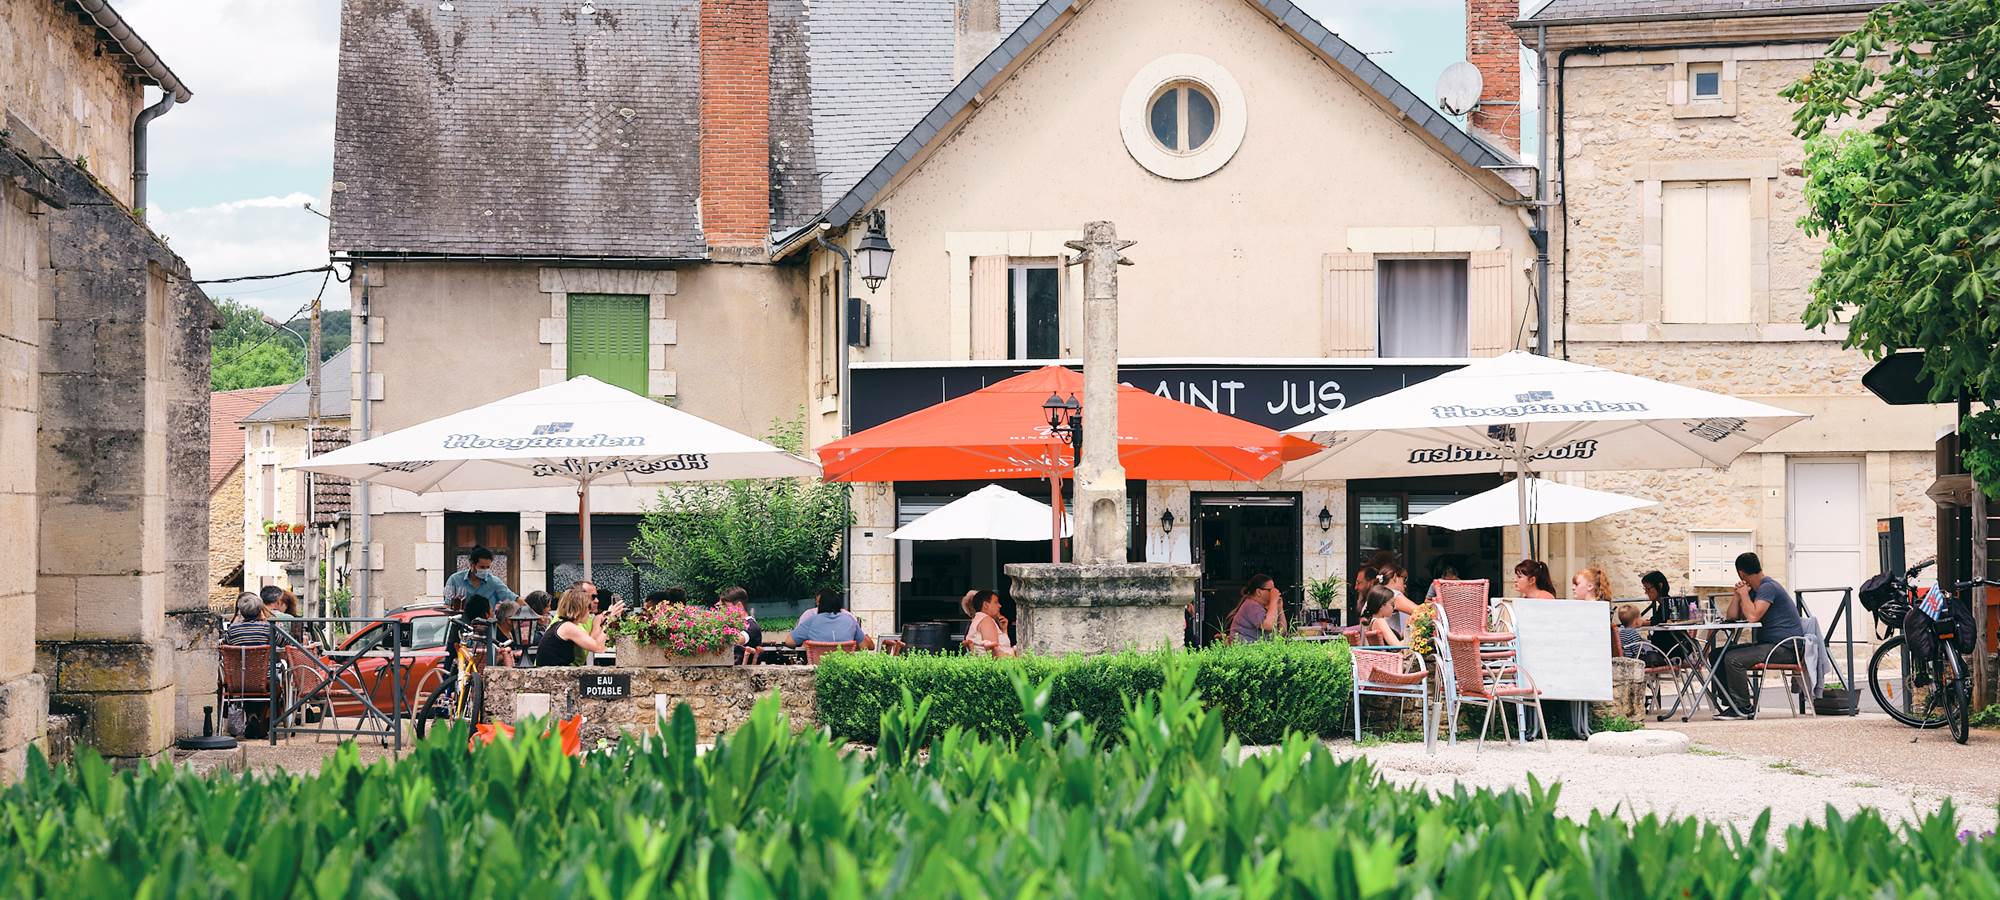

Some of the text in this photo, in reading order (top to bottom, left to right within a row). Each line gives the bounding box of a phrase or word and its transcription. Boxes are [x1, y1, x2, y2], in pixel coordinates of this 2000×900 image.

[1120, 380, 1347, 415] AINT JUS
[1431, 400, 1649, 419] Hoegaarden
[443, 433, 646, 450] Hoegaarden
[597, 676, 613, 685] EAU
[586, 686, 622, 696] POTABLE
